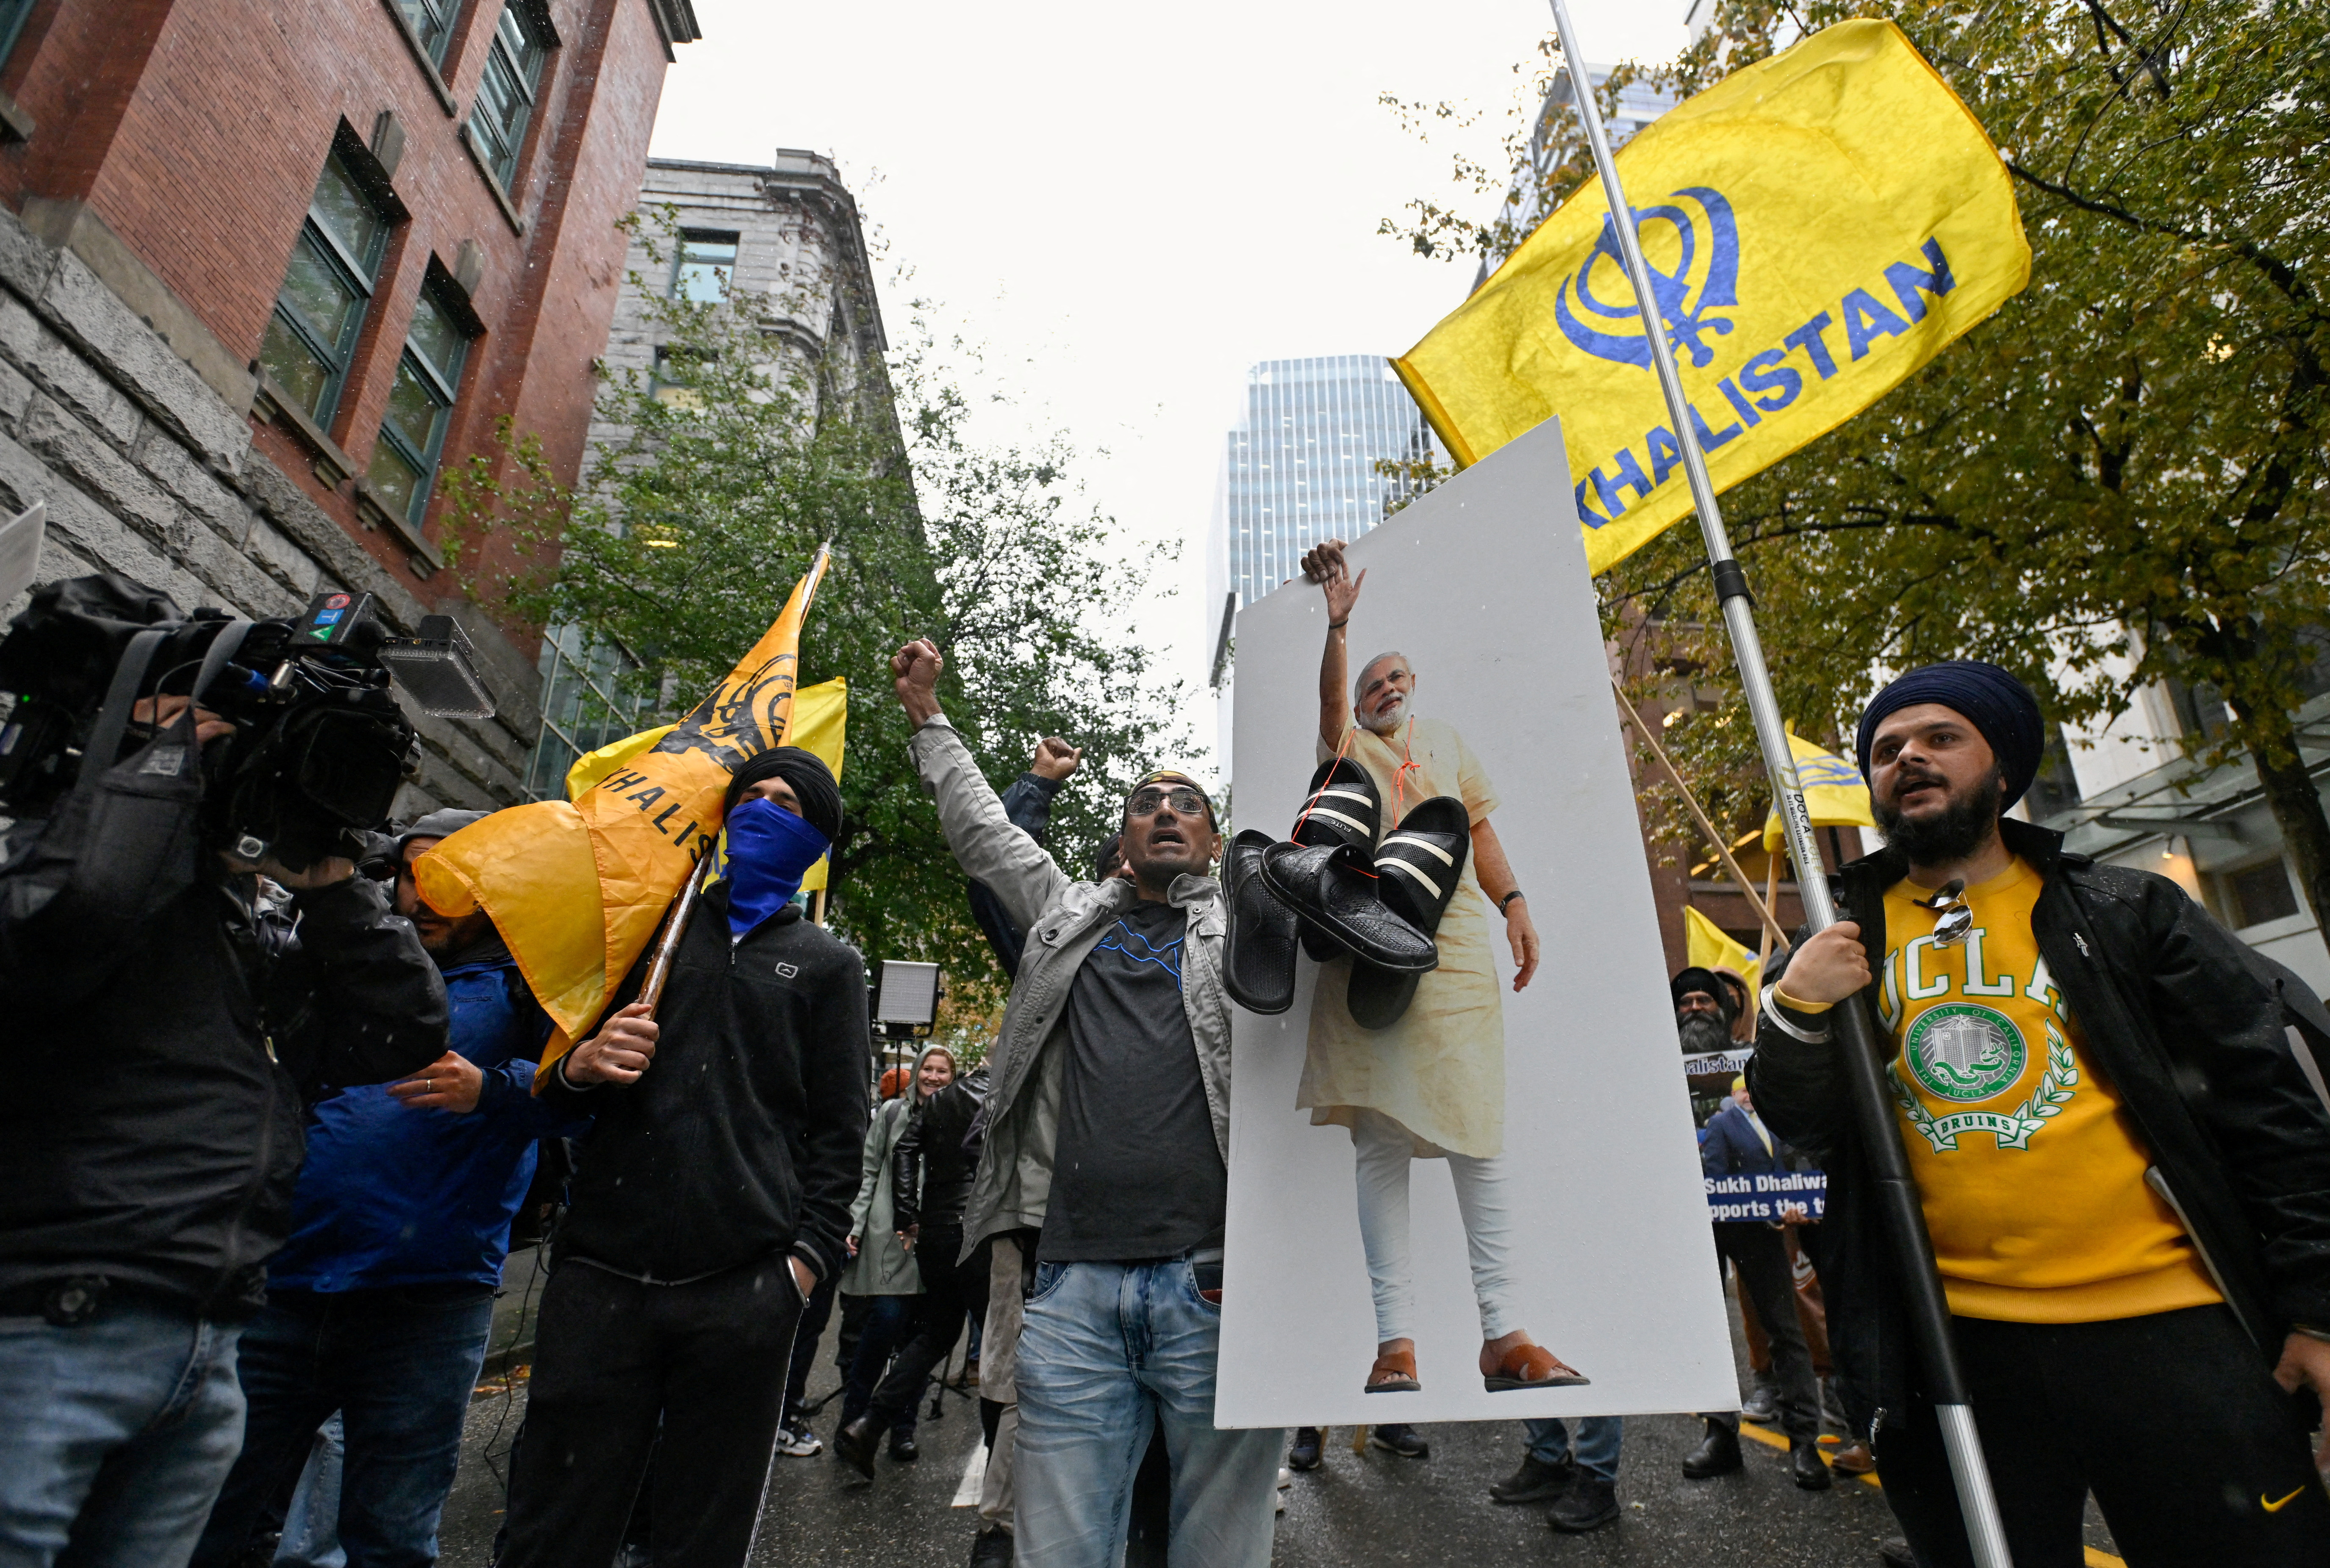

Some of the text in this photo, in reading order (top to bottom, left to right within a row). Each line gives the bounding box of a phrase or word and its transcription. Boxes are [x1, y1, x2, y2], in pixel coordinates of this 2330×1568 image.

[1330, 820, 1351, 832] FLITE
[1796, 830, 1806, 853] EXTENSION
[1911, 1008, 2021, 1086] THE UNIVERSITY OF CALIFORNIA
[1953, 1088, 1986, 1097] UCLA
[1940, 1115, 2011, 1134] BRUINS
[1704, 1176, 1752, 1194] Sukh
